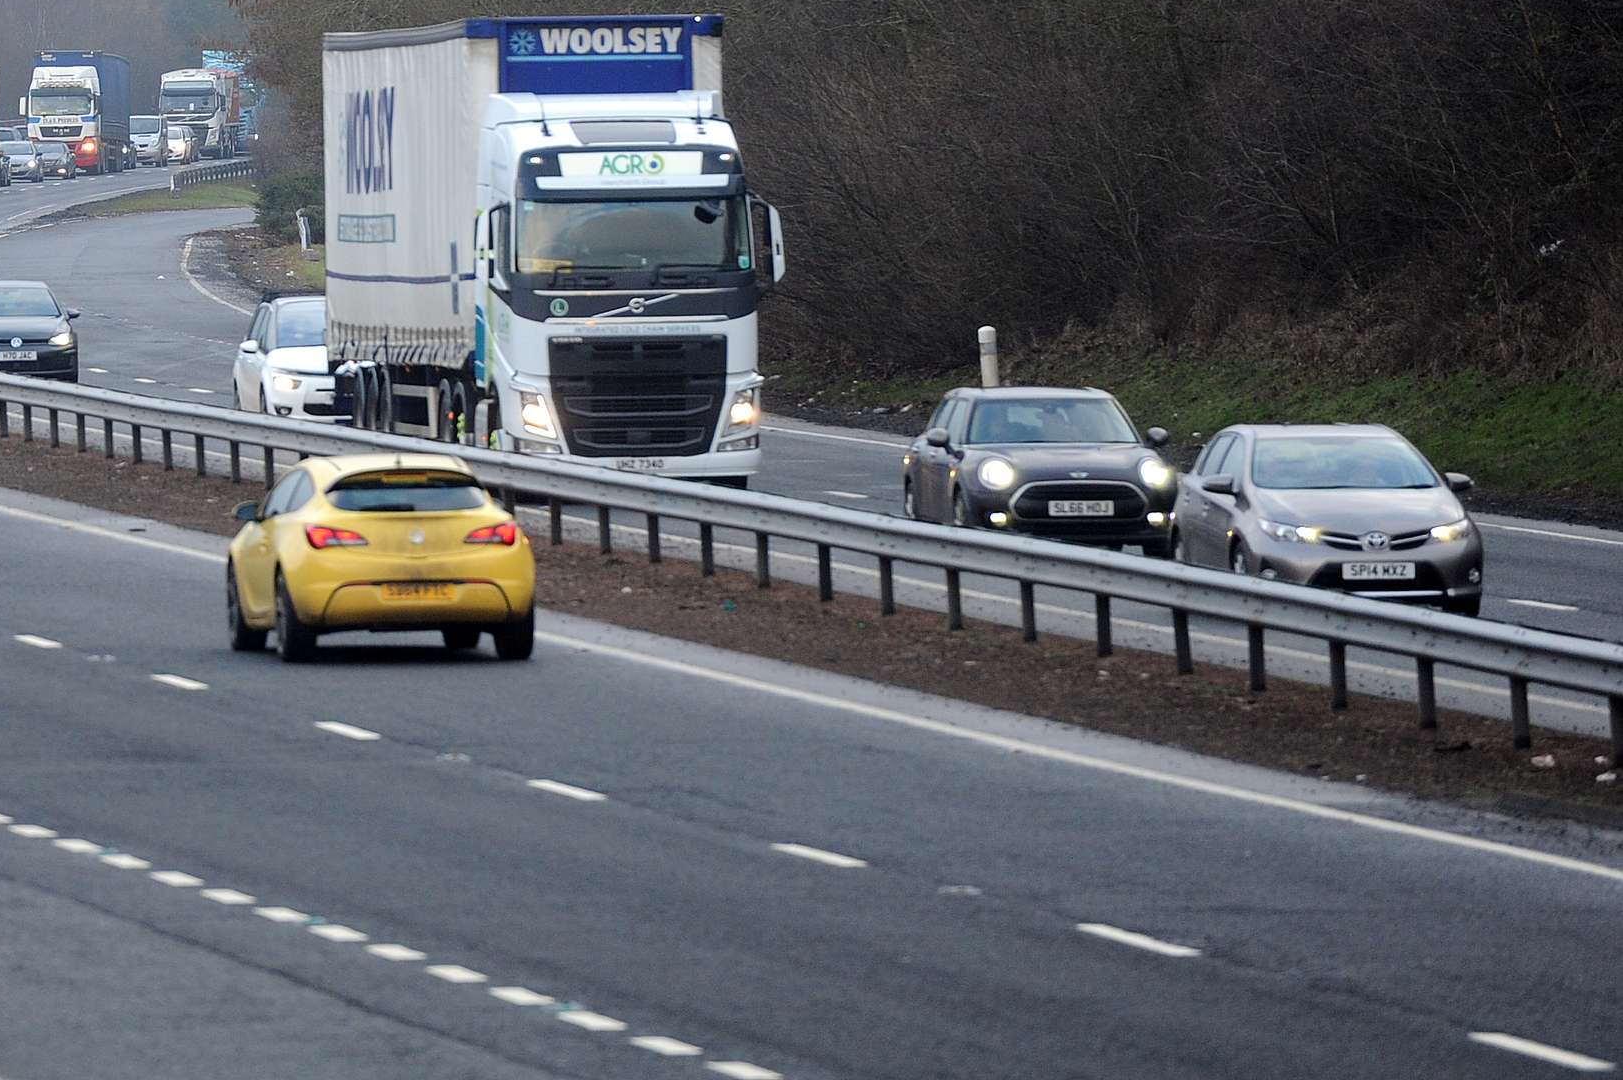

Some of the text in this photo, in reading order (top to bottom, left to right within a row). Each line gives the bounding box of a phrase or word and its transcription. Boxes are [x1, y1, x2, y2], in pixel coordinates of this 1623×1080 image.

[540, 27, 682, 54] WOOLSEY
[599, 153, 664, 175] AGRO
[1054, 502, 1083, 513] SL66
[1350, 564, 1378, 576] SP14
